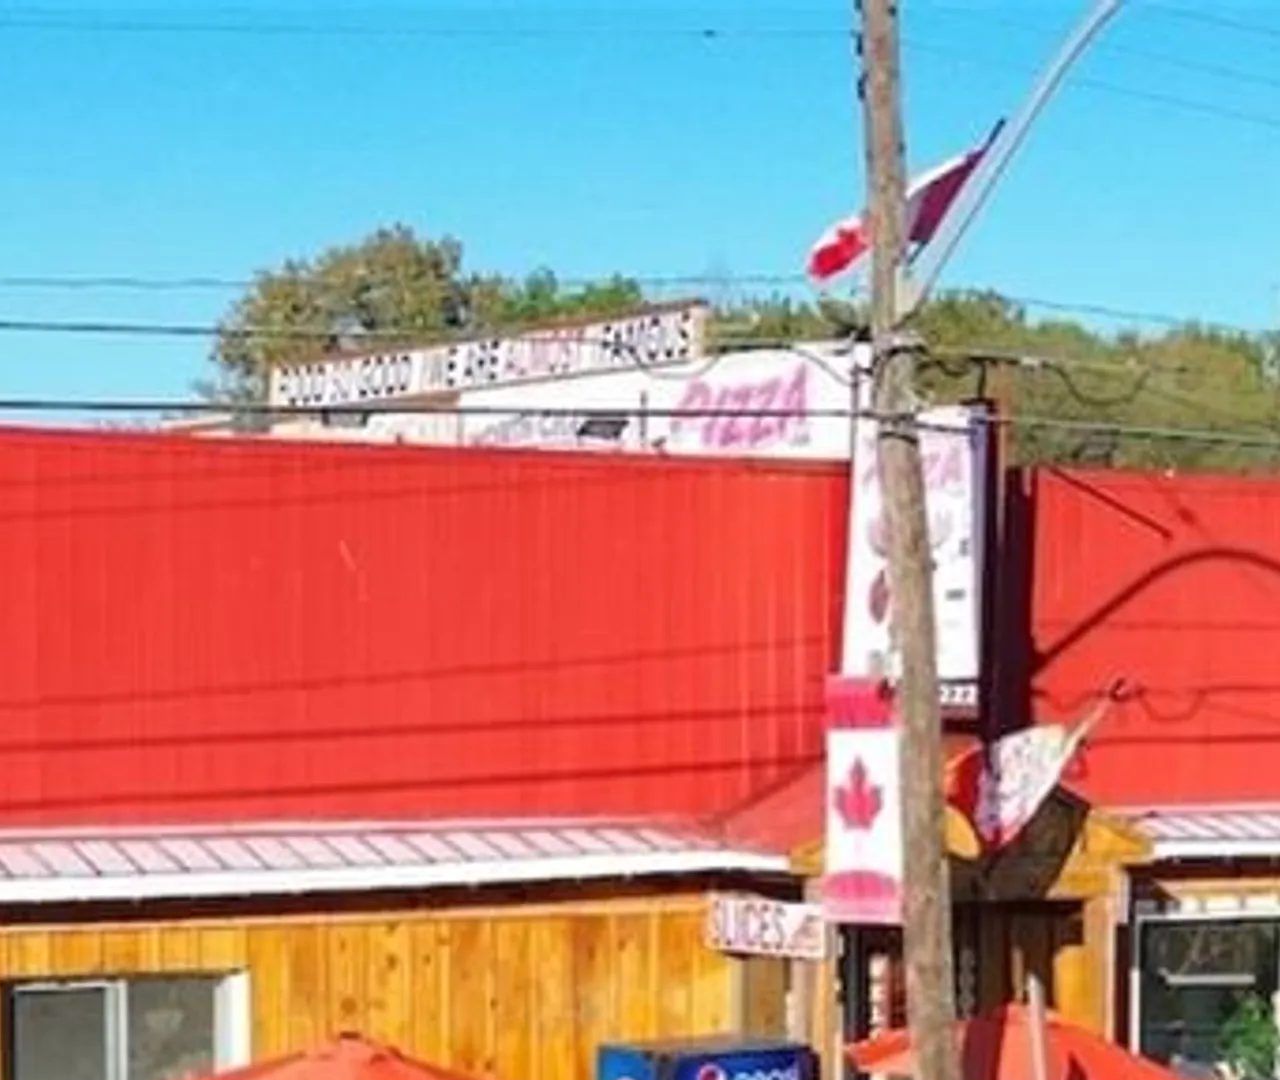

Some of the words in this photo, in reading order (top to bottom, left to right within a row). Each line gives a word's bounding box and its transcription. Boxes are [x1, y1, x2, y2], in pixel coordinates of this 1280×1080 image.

[357, 353, 412, 397] GOOD
[463, 339, 499, 382] ARE
[671, 363, 811, 447] PIZZA
